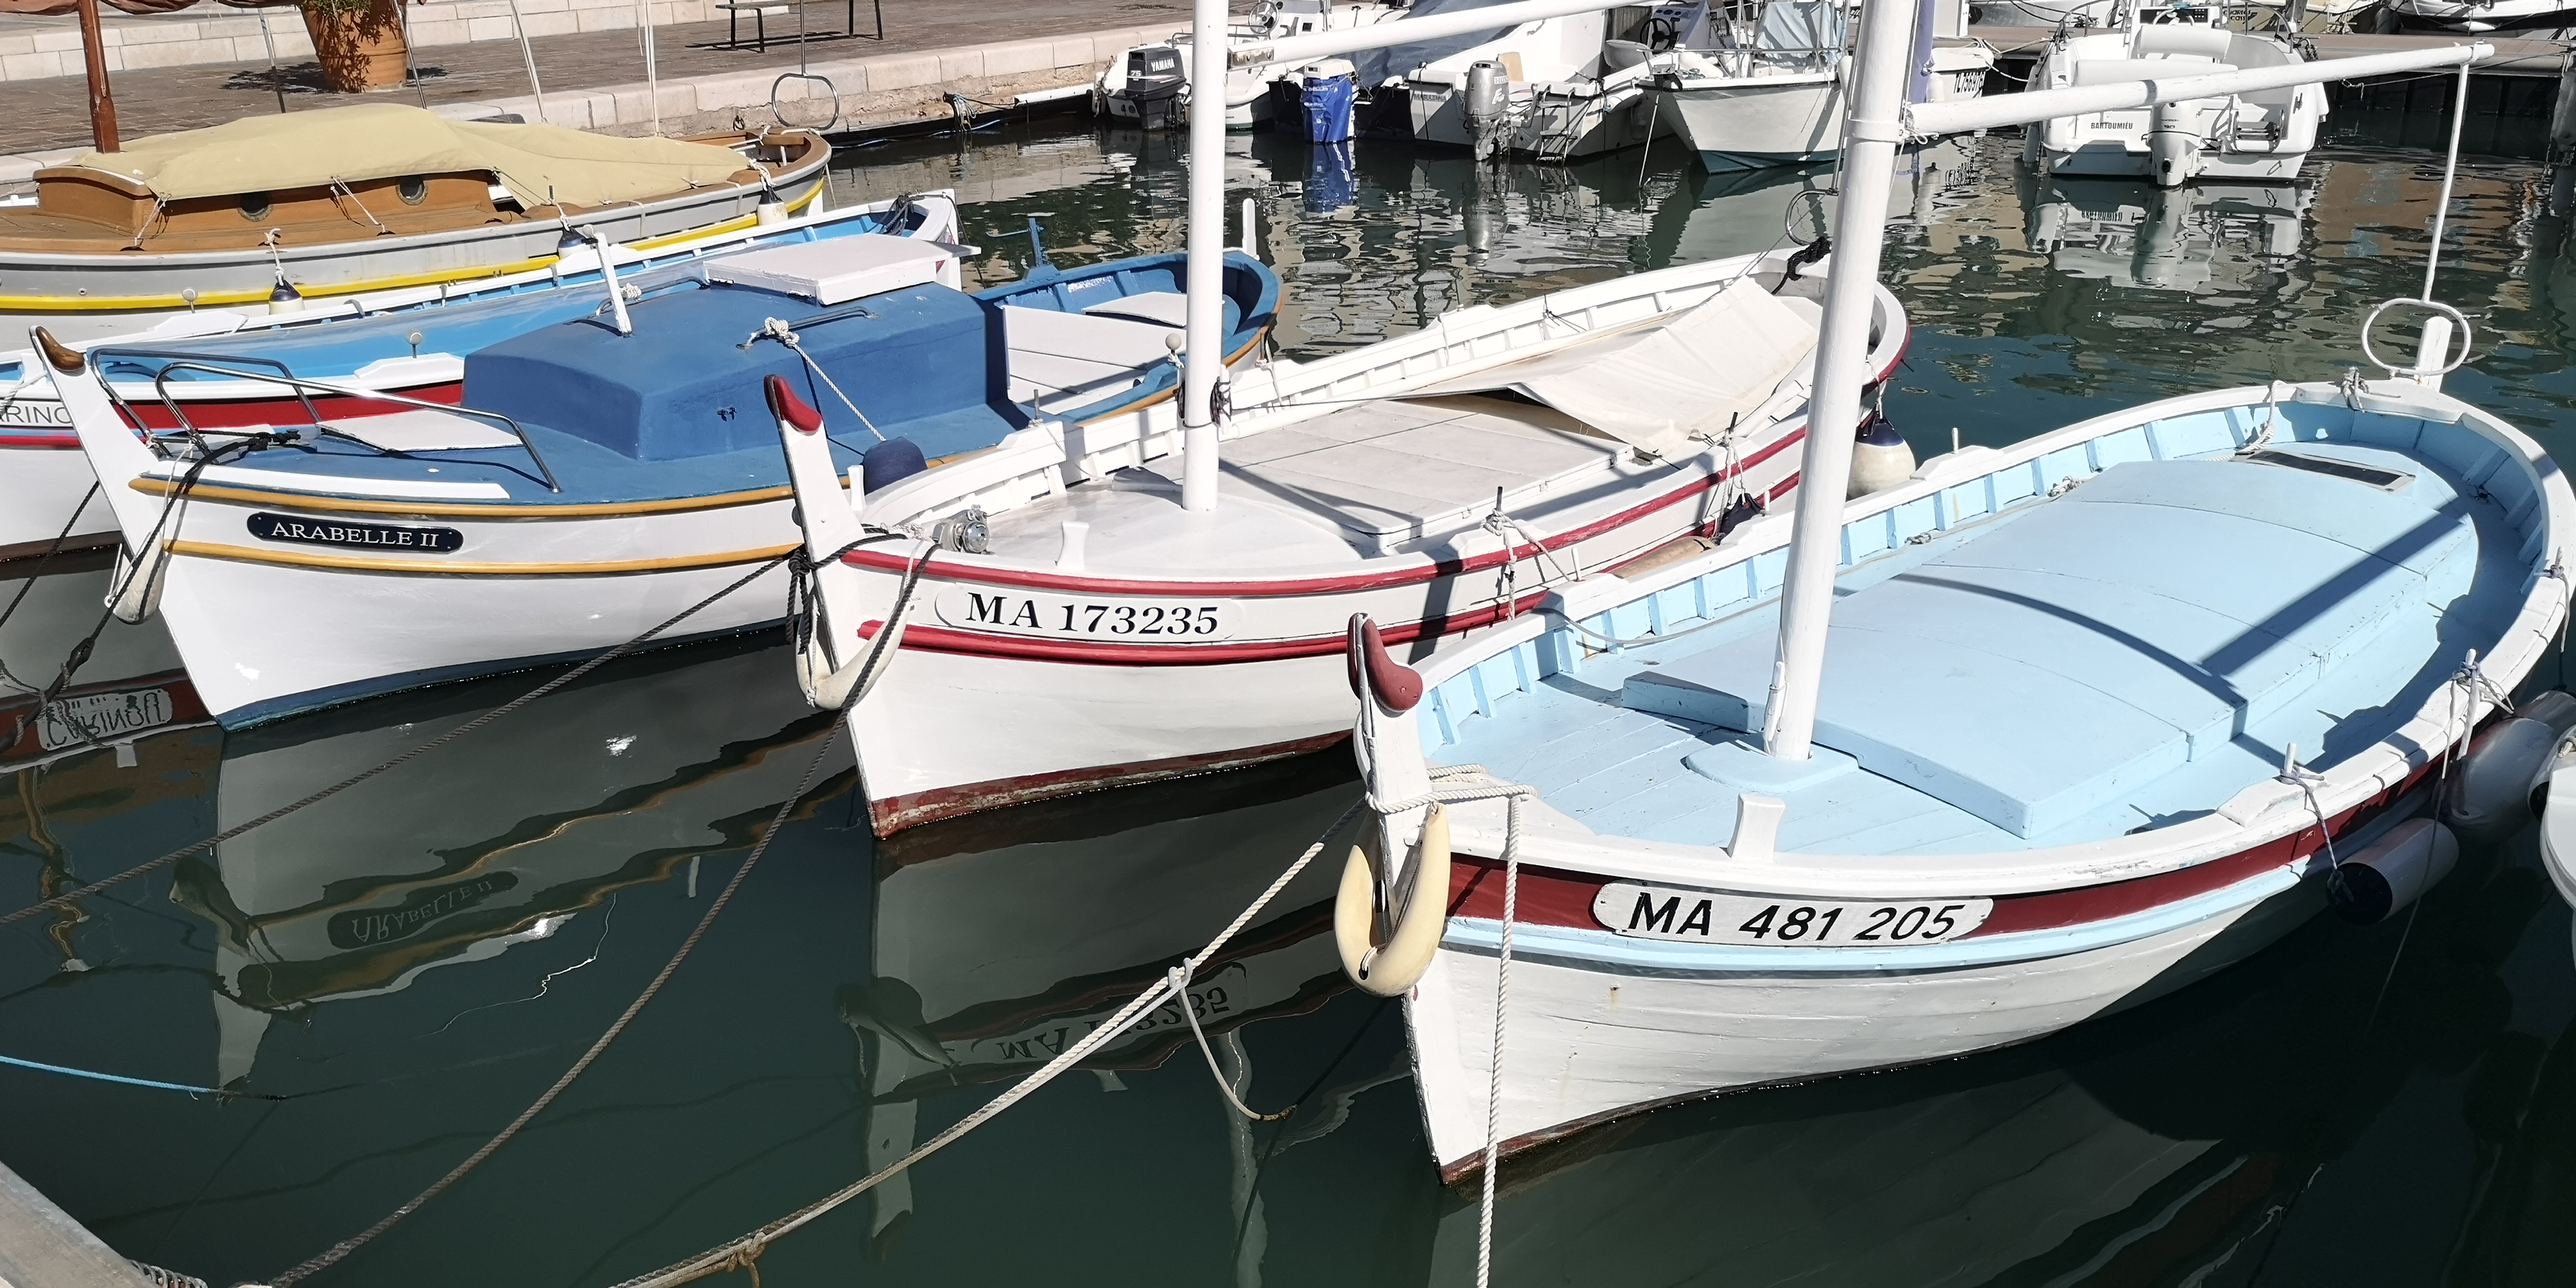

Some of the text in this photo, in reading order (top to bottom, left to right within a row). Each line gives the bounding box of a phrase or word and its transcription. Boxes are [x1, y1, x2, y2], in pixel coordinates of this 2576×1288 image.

[1151, 58, 1175, 72] YAMAHA
[0, 405, 71, 424] RINO
[271, 522, 439, 547] ARABELLE II
[965, 592, 1218, 635] MA 173235
[1628, 892, 1967, 941] MA 481 205
